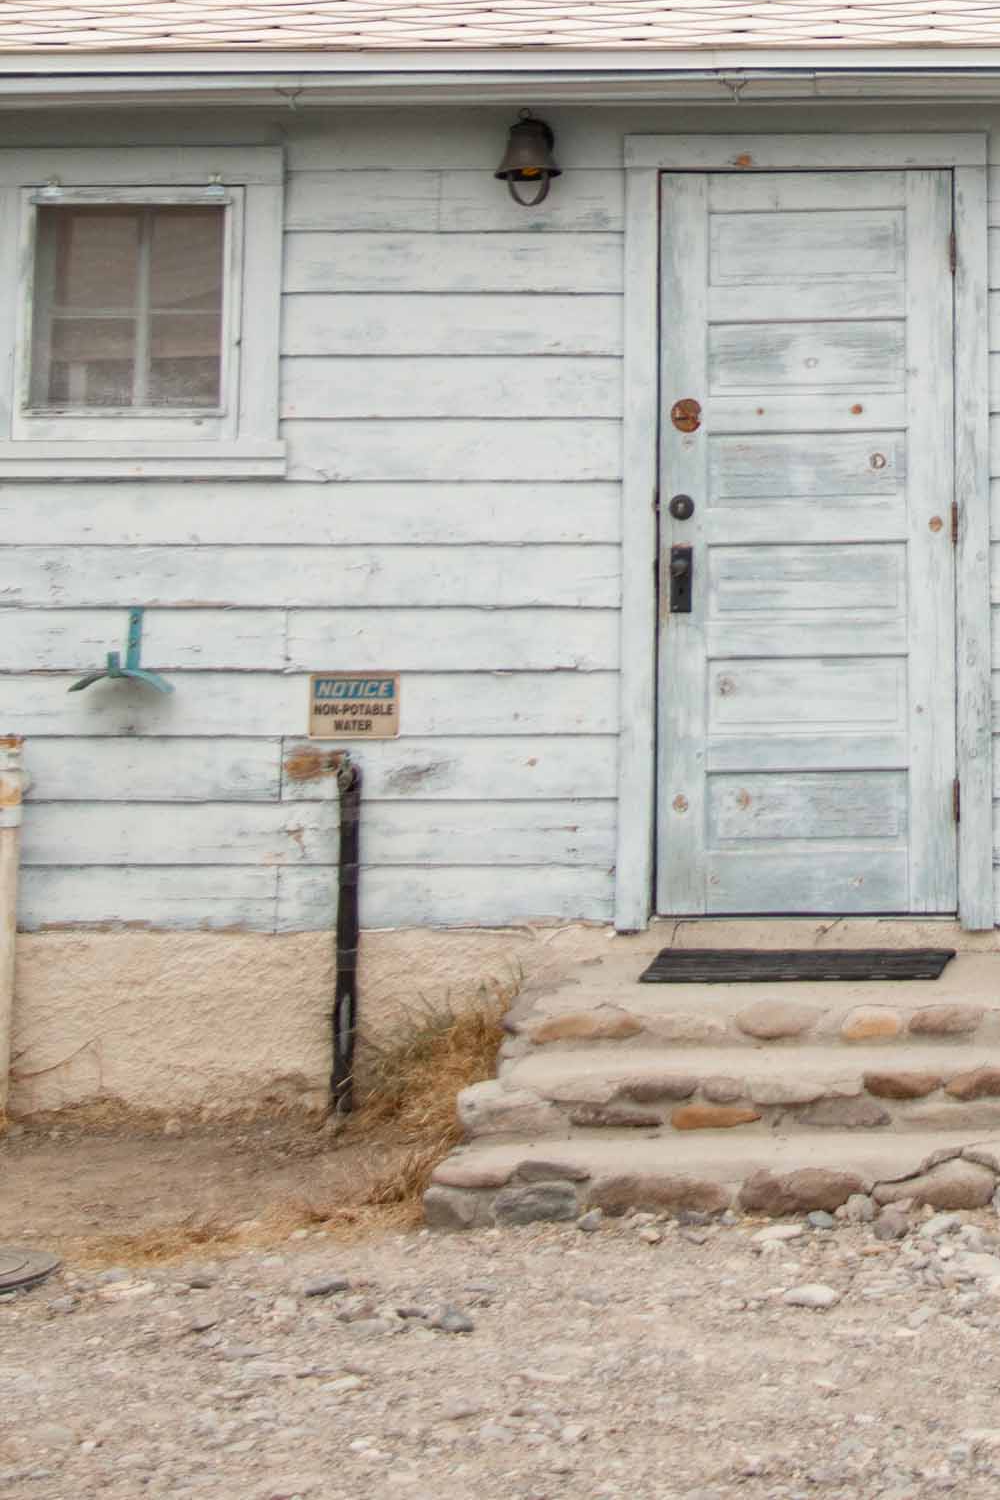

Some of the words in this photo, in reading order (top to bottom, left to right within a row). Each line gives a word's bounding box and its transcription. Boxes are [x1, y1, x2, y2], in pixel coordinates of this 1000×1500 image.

[317, 681, 393, 697] NOTICE
[314, 703, 393, 716] NON-POTABLE
[334, 719, 373, 732] WATER
